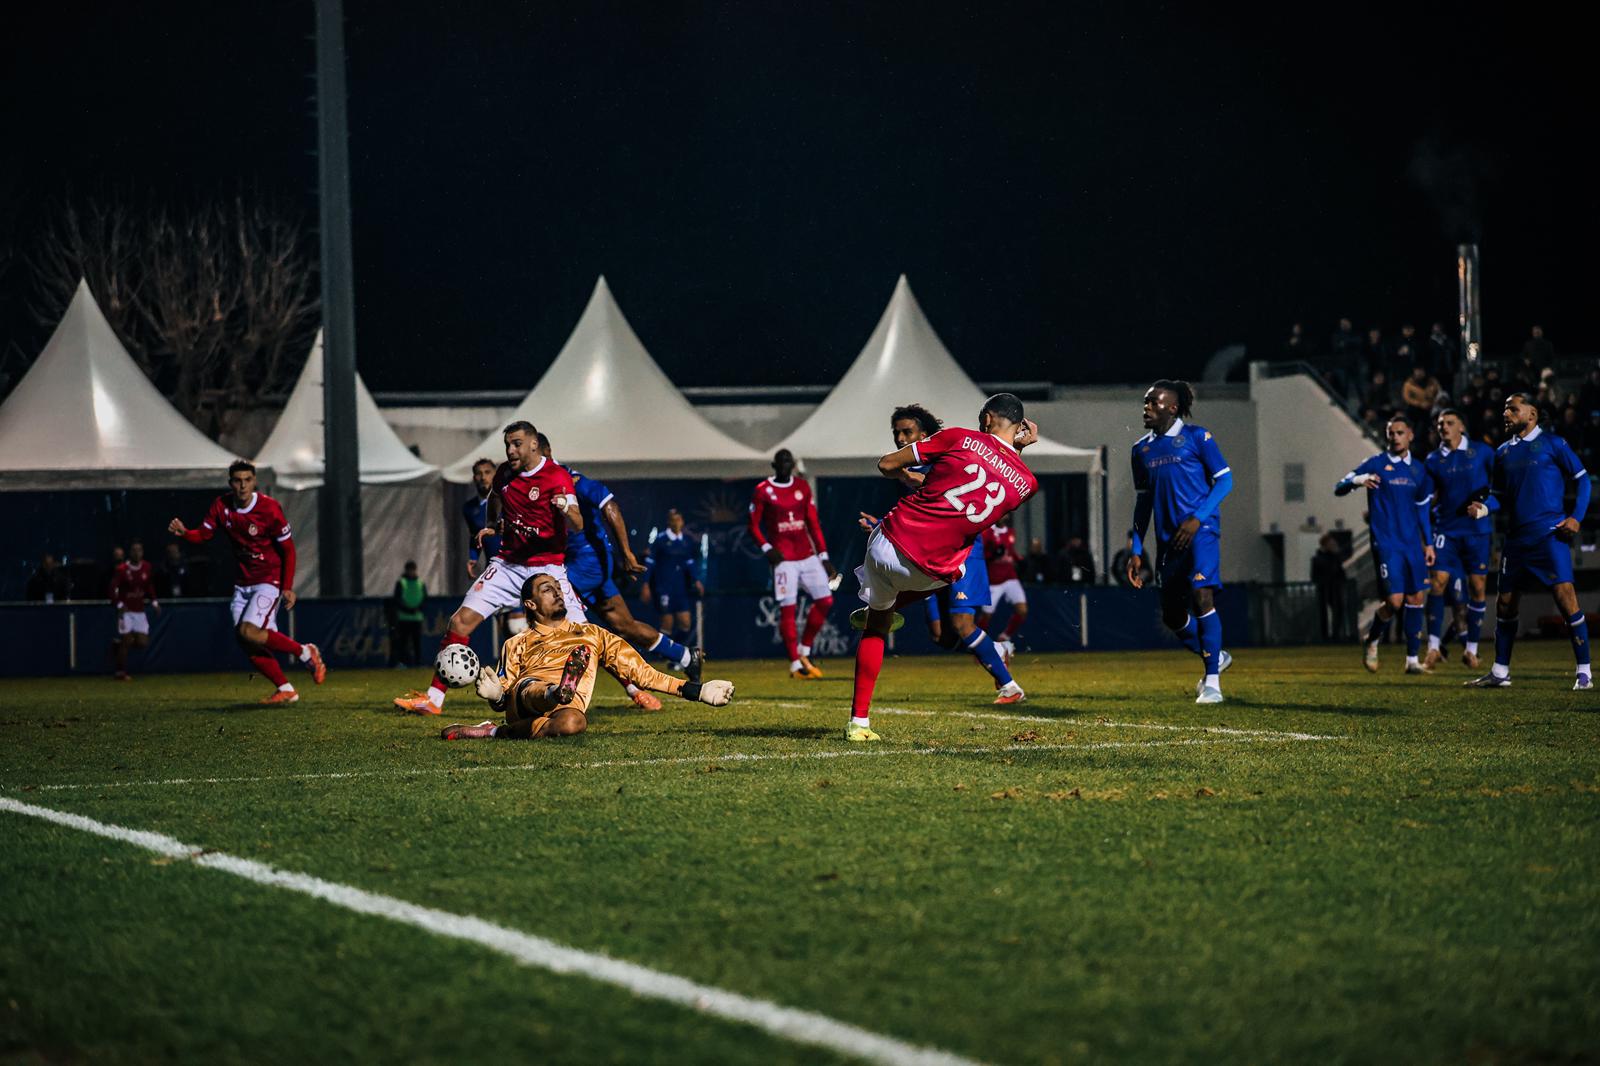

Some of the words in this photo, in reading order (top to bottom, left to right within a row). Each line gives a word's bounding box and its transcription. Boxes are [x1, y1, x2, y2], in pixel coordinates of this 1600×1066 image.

[943, 463, 1006, 524] 23
[962, 436, 1031, 500] BOUZAMOUCHA
[775, 572, 788, 586] 21
